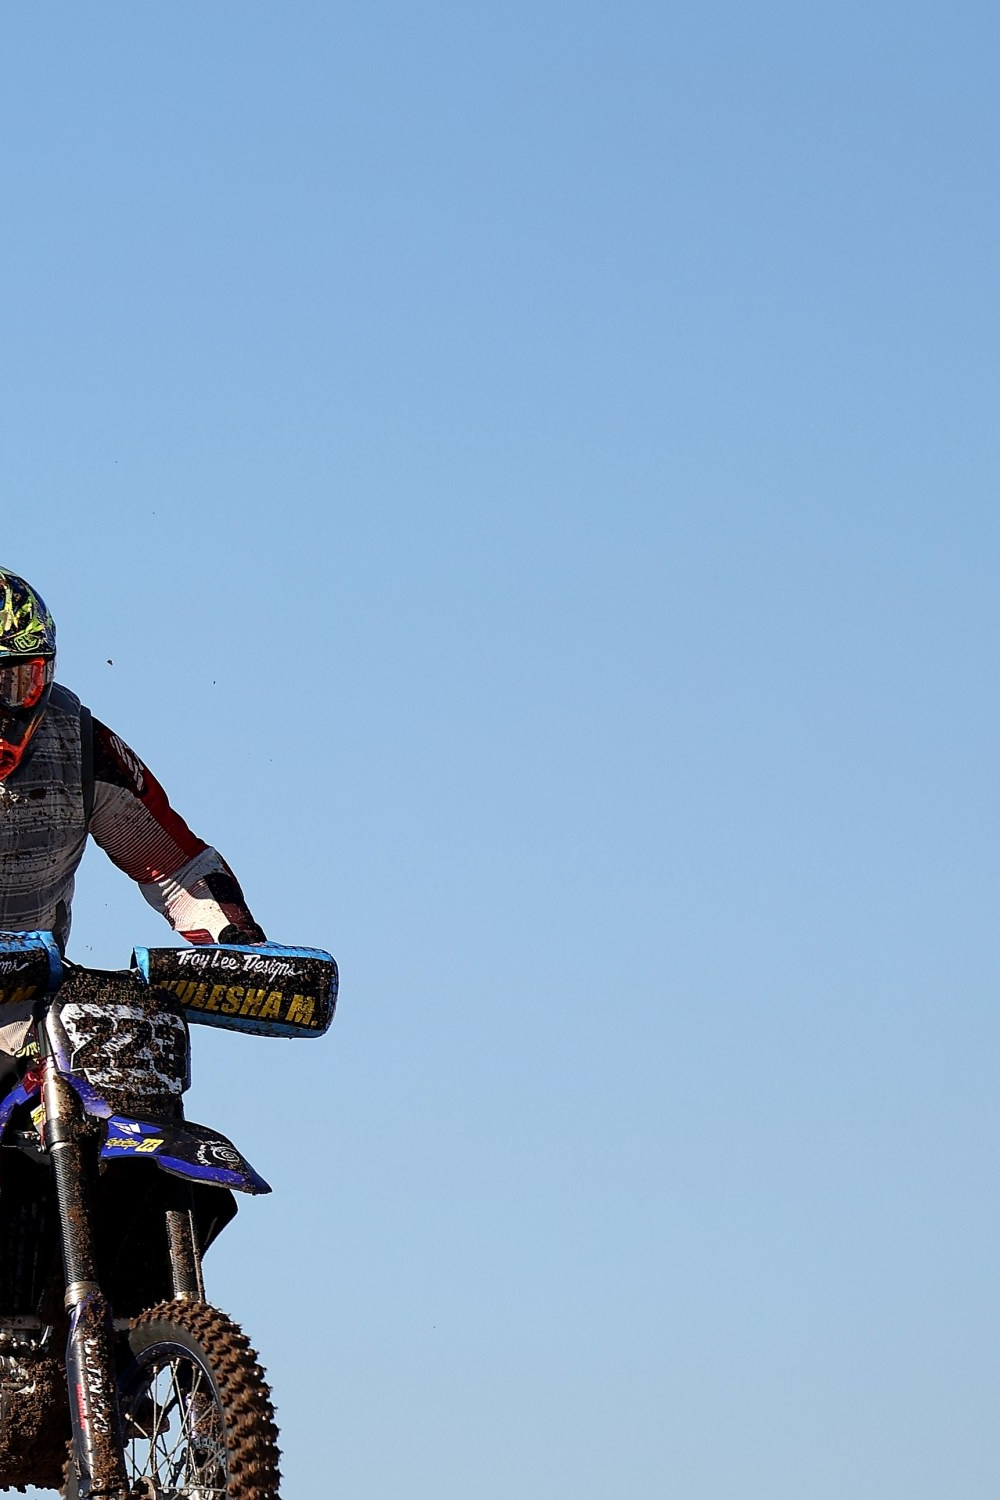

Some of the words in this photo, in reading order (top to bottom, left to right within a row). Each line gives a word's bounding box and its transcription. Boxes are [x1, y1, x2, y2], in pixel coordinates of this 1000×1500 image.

[176, 949, 209, 976] Troy
[211, 950, 240, 970] Lee
[243, 954, 303, 983] Designs
